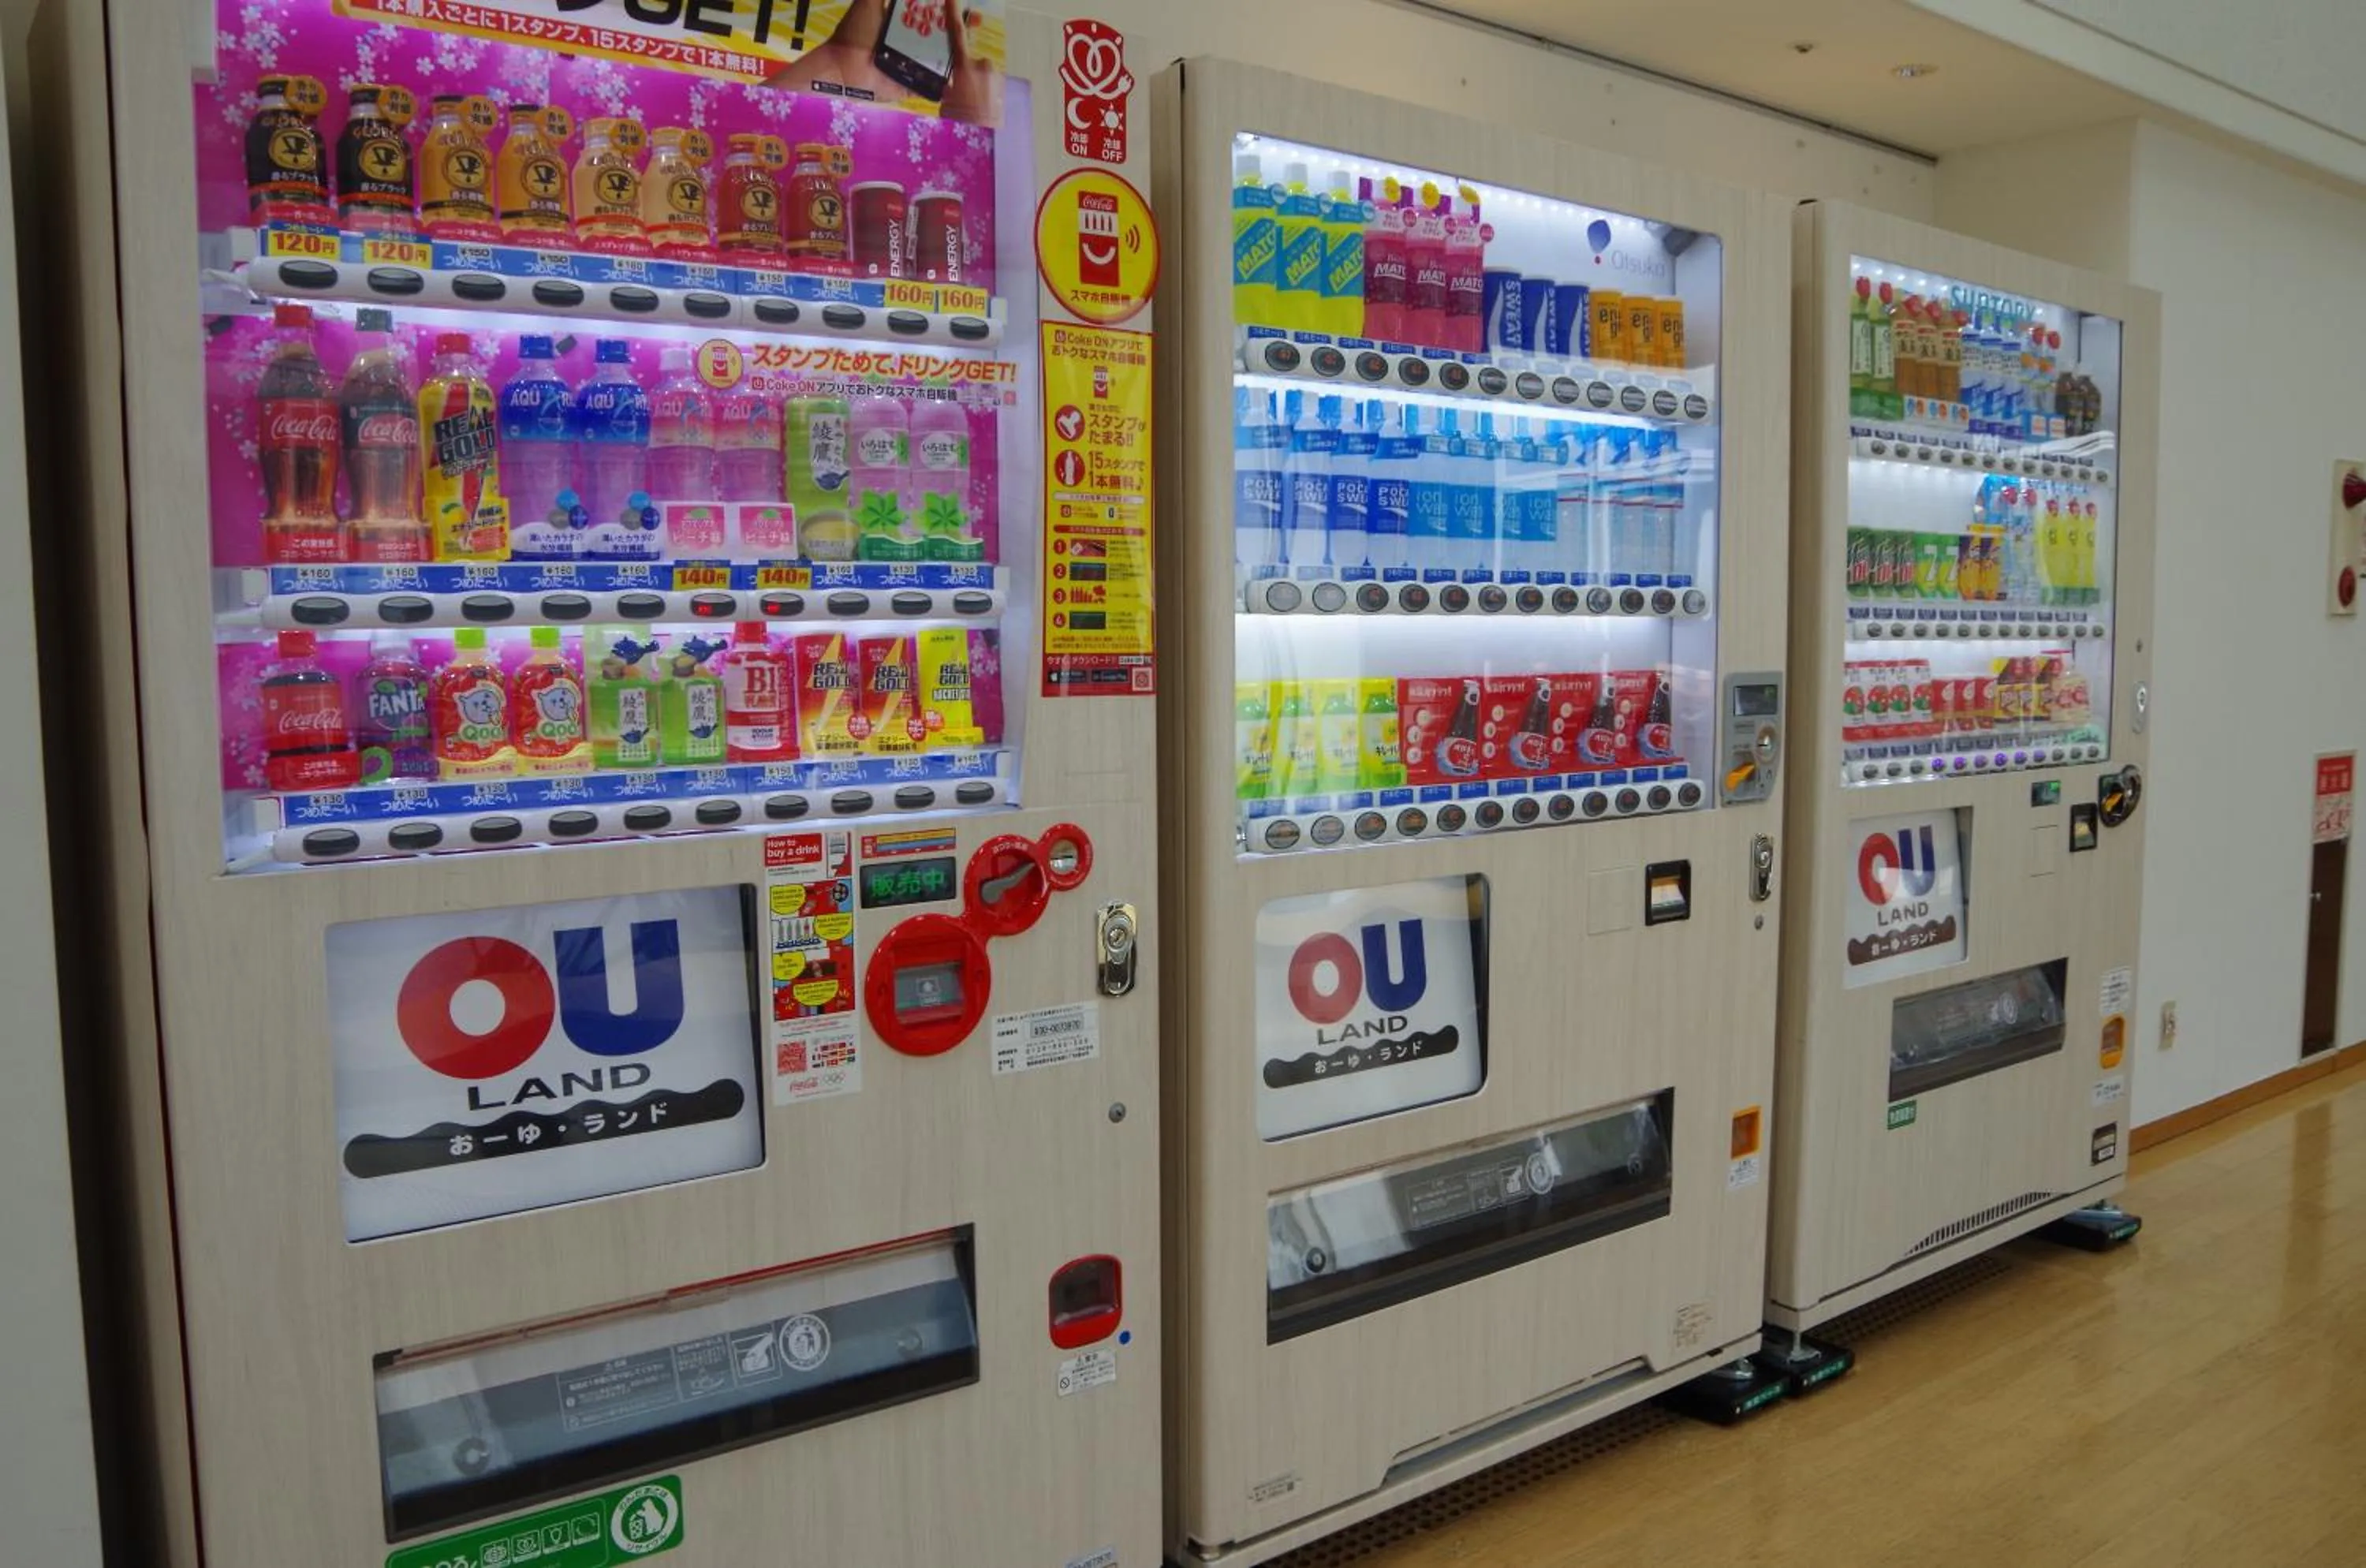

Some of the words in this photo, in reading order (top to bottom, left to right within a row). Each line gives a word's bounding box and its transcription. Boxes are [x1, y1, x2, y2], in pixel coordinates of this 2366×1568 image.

[1072, 144, 1088, 156] ON
[1101, 149, 1122, 162] OFF
[273, 233, 336, 255] 120円
[367, 242, 427, 263] 120円
[889, 218, 901, 277] ENERGY
[946, 223, 958, 282] ENERGY
[1237, 229, 1276, 281] MATC
[1611, 250, 1665, 278] Otsuka
[887, 282, 934, 305] 160円
[1450, 276, 1483, 290] MATC
[942, 289, 985, 309] 160円
[752, 344, 1017, 383] スタンプためて、ドリンクGET!
[766, 377, 797, 393] Coke
[271, 413, 337, 442] Coca-Cola
[358, 415, 417, 444] Coca-Cola
[435, 405, 494, 443] REAL
[860, 439, 896, 450] いろはす
[921, 442, 957, 453] いろはす
[676, 569, 726, 584] 140円
[761, 569, 808, 584] 140円
[368, 689, 426, 719] FANTA
[278, 707, 342, 734] Coca-Cola
[767, 838, 786, 848] How
[787, 838, 796, 846] to
[767, 848, 785, 859] buy
[795, 844, 820, 856] drink
[1858, 824, 1935, 906] OU
[871, 866, 946, 898] 販売中
[1877, 902, 1929, 927] LAND
[1288, 918, 1427, 1025] OU
[397, 918, 685, 1081] OU
[1316, 1014, 1408, 1046] LAND
[1314, 1040, 1423, 1074] おーゆ・ランド
[467, 1062, 651, 1111] LAND
[450, 1100, 668, 1155] おーゆ・ランド
